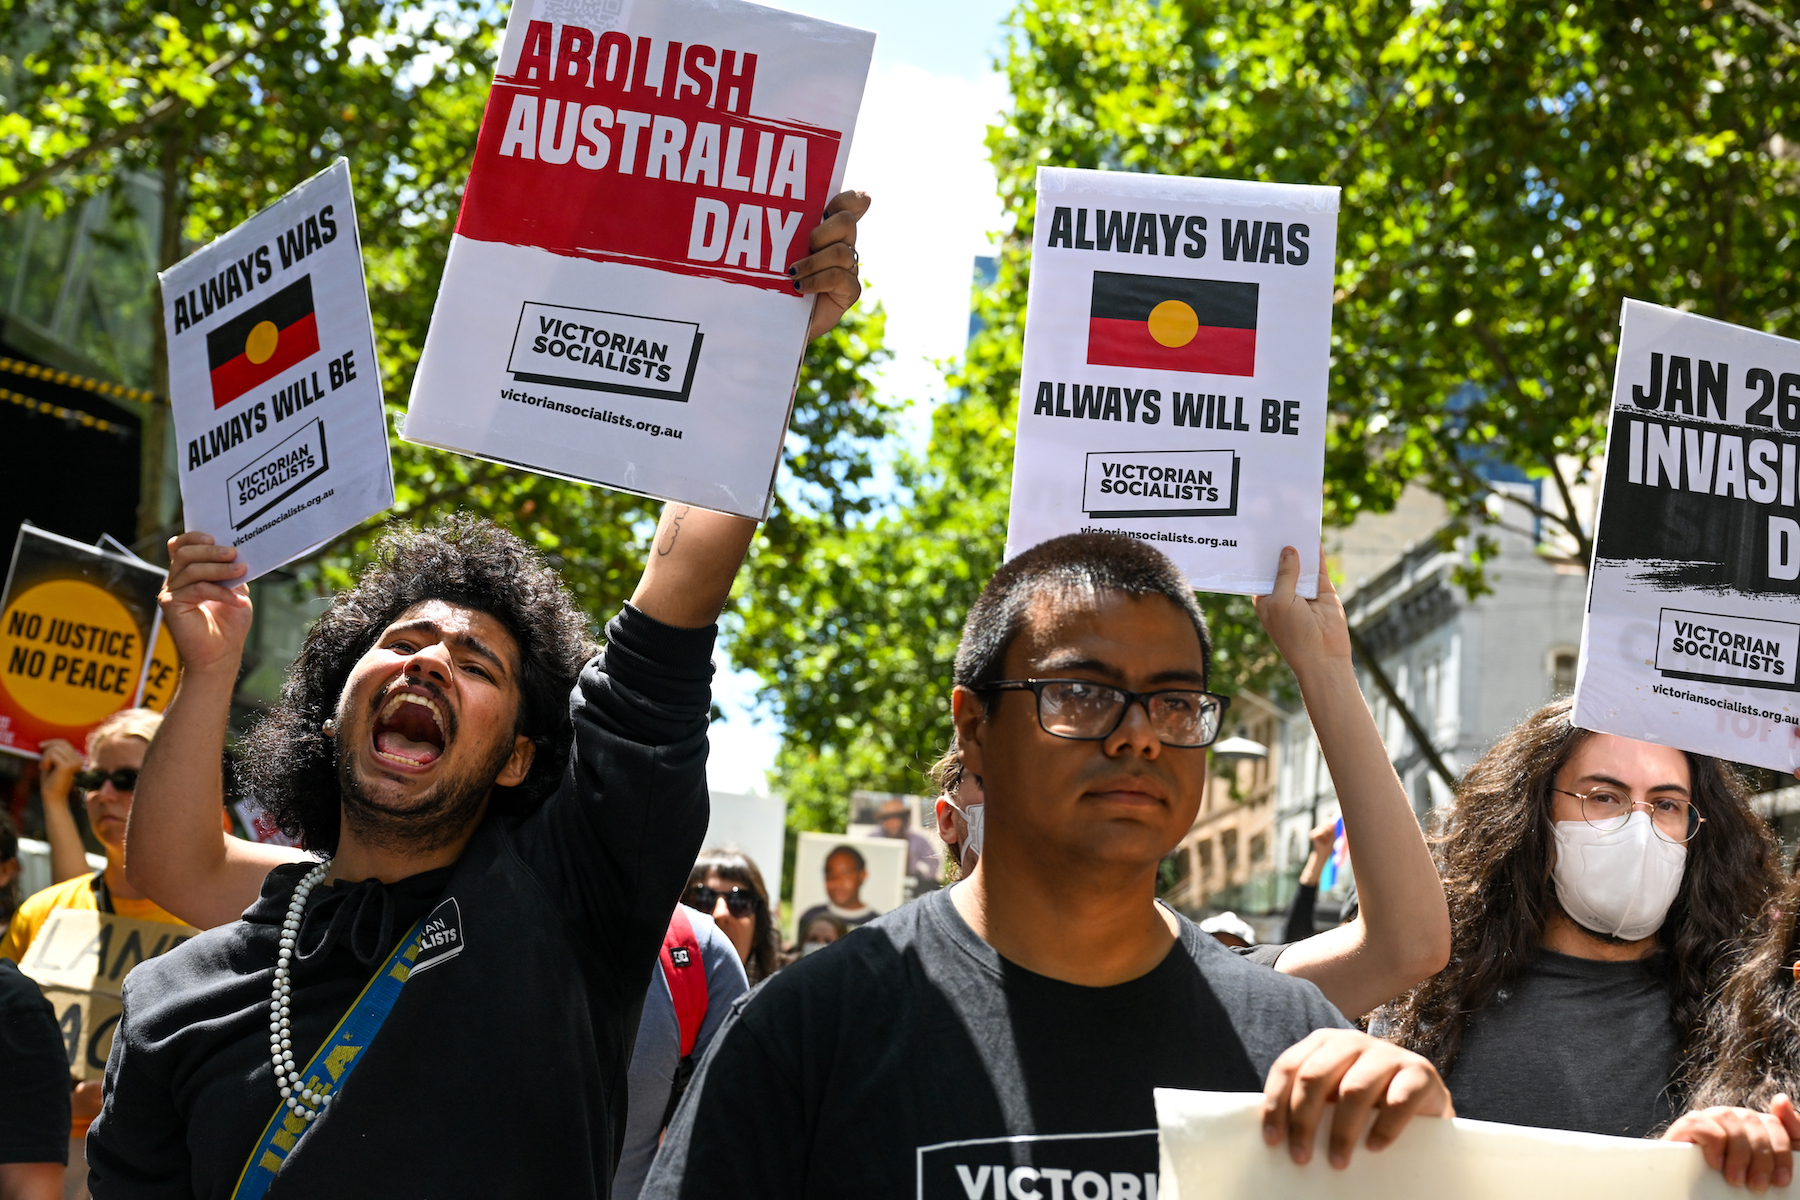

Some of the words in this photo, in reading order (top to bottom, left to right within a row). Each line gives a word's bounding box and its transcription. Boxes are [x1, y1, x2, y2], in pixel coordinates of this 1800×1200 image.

[514, 20, 758, 117] ABOLISH
[498, 94, 808, 202] AUSTRALIA
[687, 197, 803, 273] DAY
[1047, 206, 1208, 259] ALWAYS
[1222, 218, 1310, 266] WAS
[174, 245, 272, 336] ALWAYS
[276, 204, 338, 271] WAS
[532, 336, 672, 383] SOCIALISTS
[539, 315, 669, 362] VICTORIAN
[189, 402, 268, 472] ALWAYS
[271, 371, 326, 423] WILL
[328, 350, 357, 391] BE
[500, 389, 683, 440] victoriansocialists.org.au
[1033, 381, 1161, 425] ALWAYS
[1172, 391, 1250, 432] WILL
[1260, 399, 1301, 436] BE
[1632, 352, 1728, 421] JAN
[1745, 367, 1800, 432] 26
[237, 444, 310, 492] VICTORIAN
[239, 455, 315, 506] SOCIALISTS
[1101, 462, 1213, 486] VICTORIAN
[1628, 420, 1800, 507] INVASI
[1100, 479, 1219, 503] SOCIALISTS
[232, 488, 335, 547] victoriansocialists.org.au
[7, 609, 43, 640] NO
[44, 619, 135, 659] JUSTICE
[1672, 637, 1785, 676] SOCIALISTS
[1674, 620, 1780, 658] VICTORIAN
[8, 646, 46, 680] NO
[50, 654, 131, 695] PEACE
[1652, 684, 1799, 726] victoriansocialists.org.au
[33, 918, 190, 981] LAN
